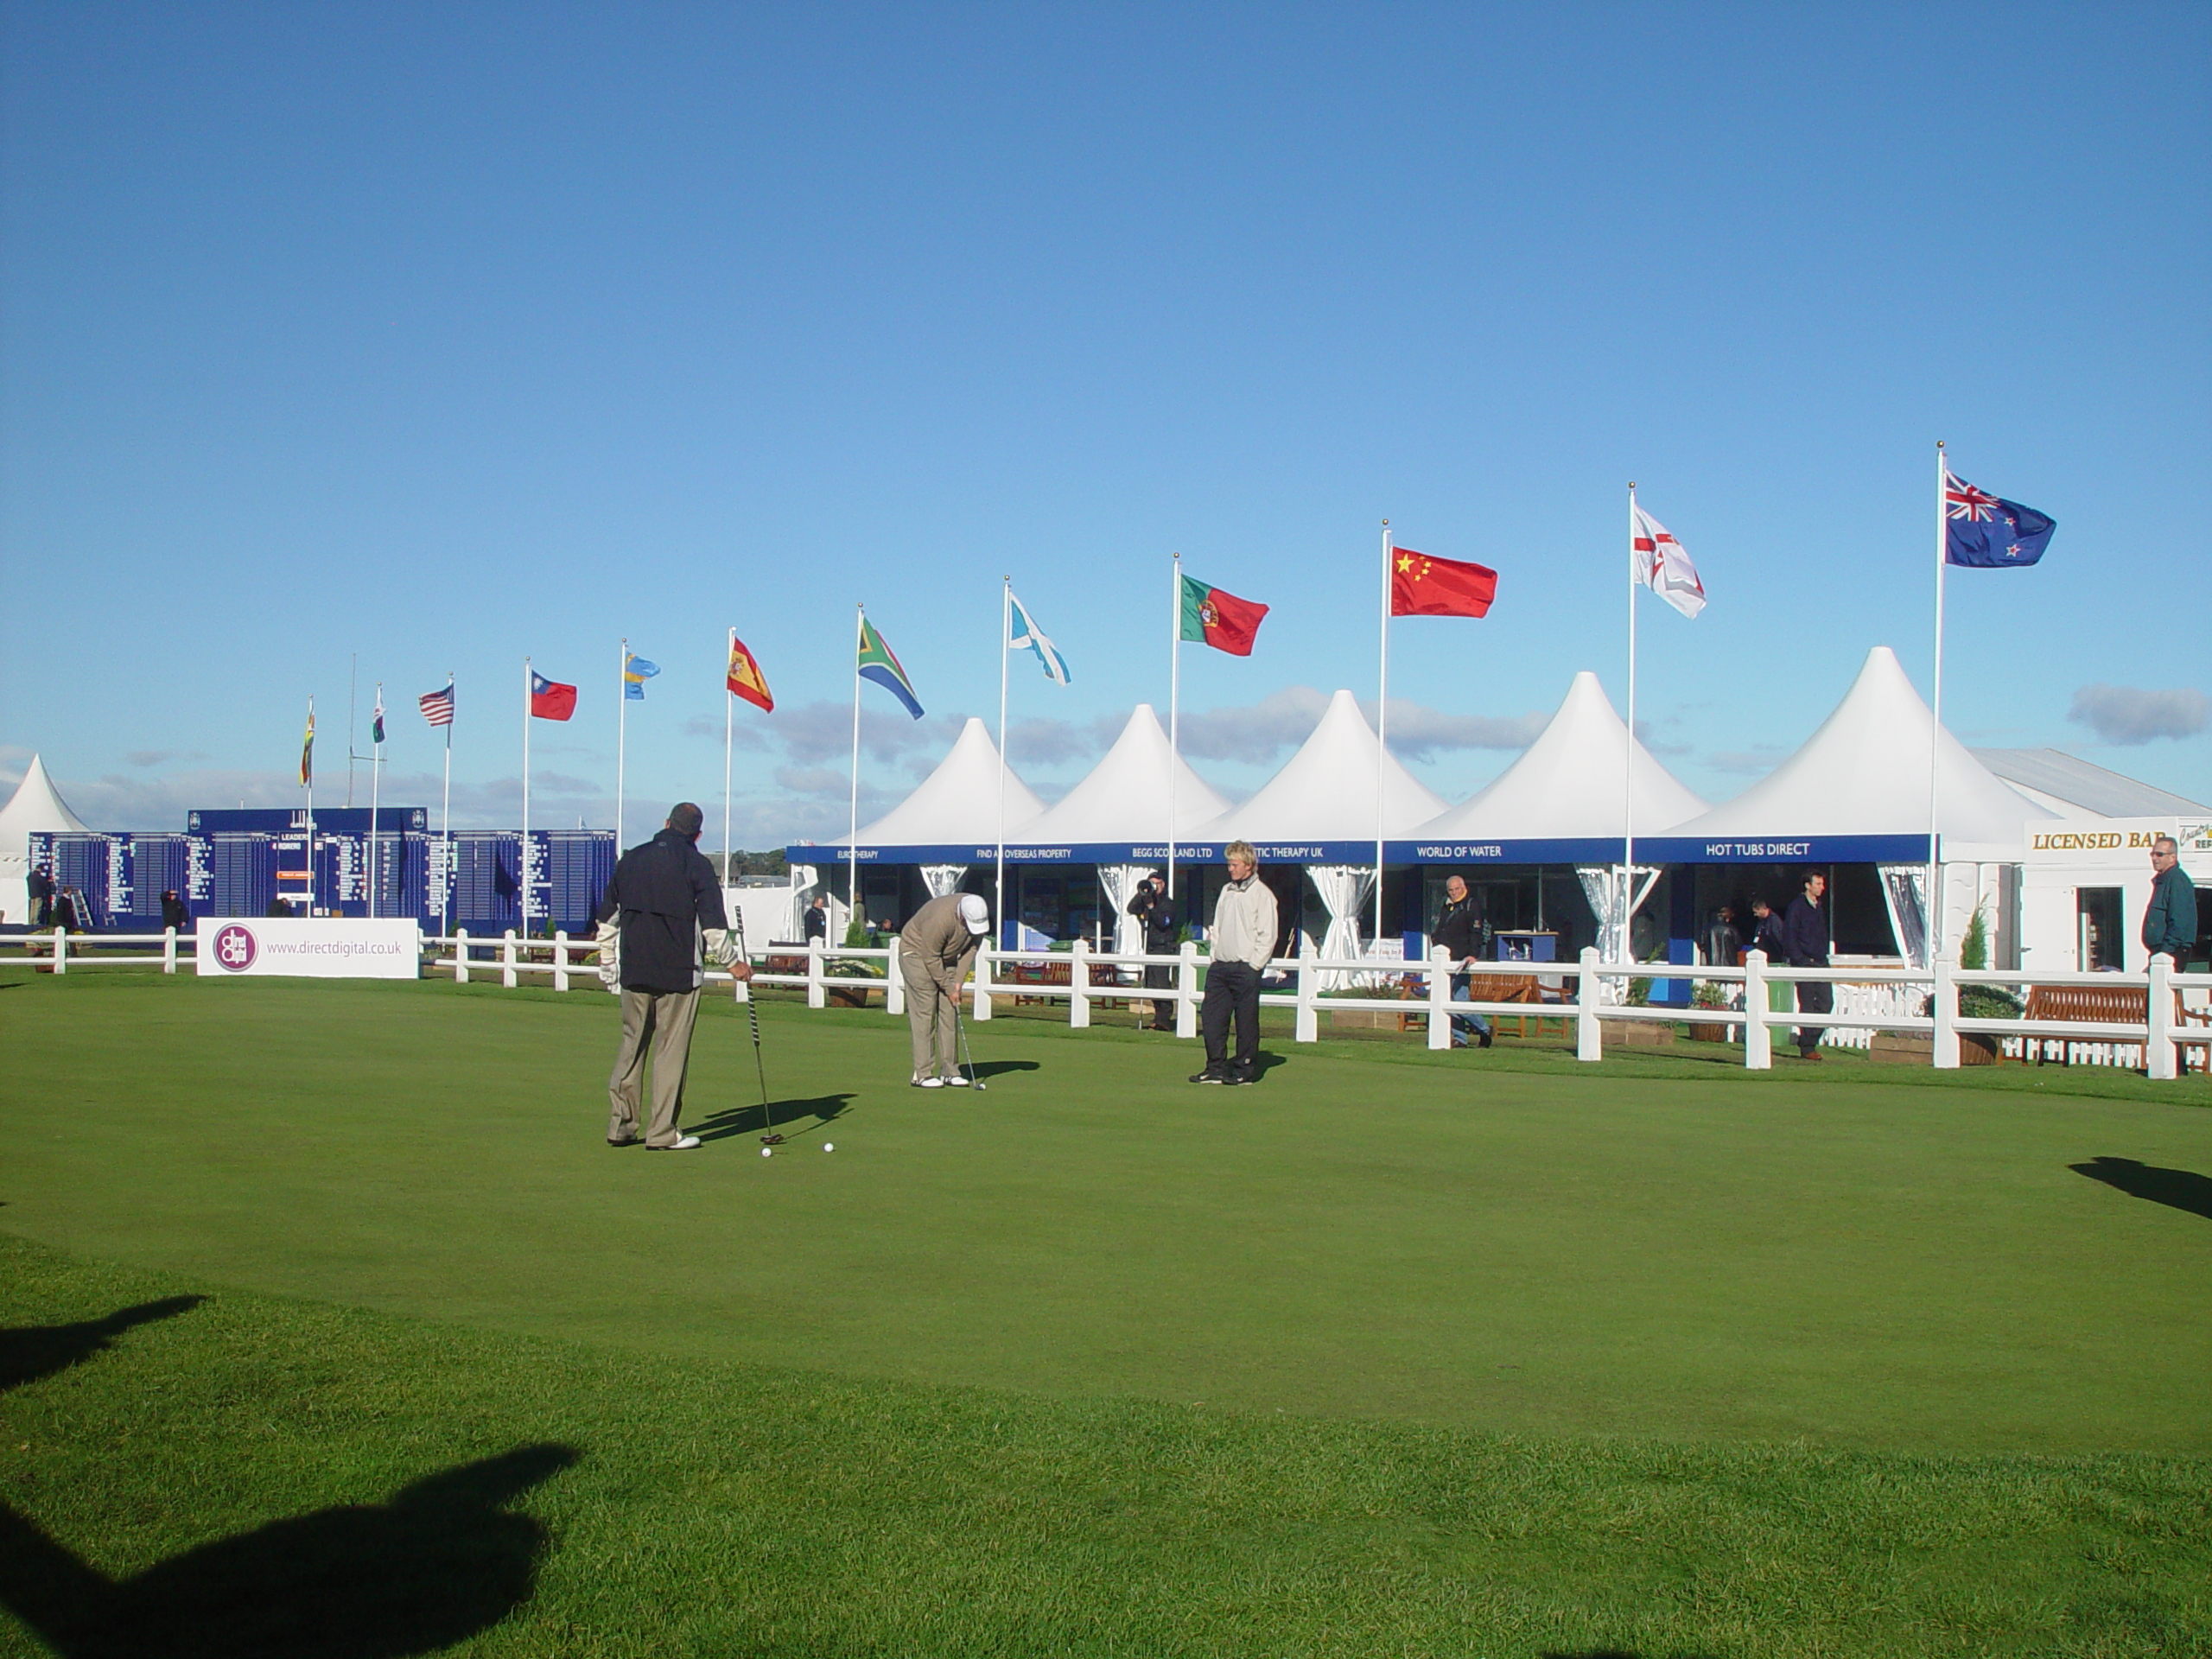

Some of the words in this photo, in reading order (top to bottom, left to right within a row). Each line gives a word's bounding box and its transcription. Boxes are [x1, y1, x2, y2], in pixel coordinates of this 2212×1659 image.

[2032, 833, 2122, 850] LICENSED
[976, 849, 992, 858] FIND
[1004, 849, 1037, 859] OVERSEAS
[1038, 849, 1072, 858] PROPERTY
[1133, 848, 1153, 858] BEGG
[1154, 848, 1196, 858] SCOLAND
[1197, 848, 1213, 858] LTD
[1272, 848, 1310, 858] THERAPY
[1311, 848, 1324, 858] UK
[1417, 847, 1452, 857] WORLD
[1453, 847, 1467, 857] OF
[1469, 846, 1503, 857] WATER
[1707, 844, 1732, 855] HOT
[1734, 843, 1764, 855] TUBS
[1767, 843, 1810, 855] DIRECT
[266, 940, 402, 957] www.directdigital.co.uk
